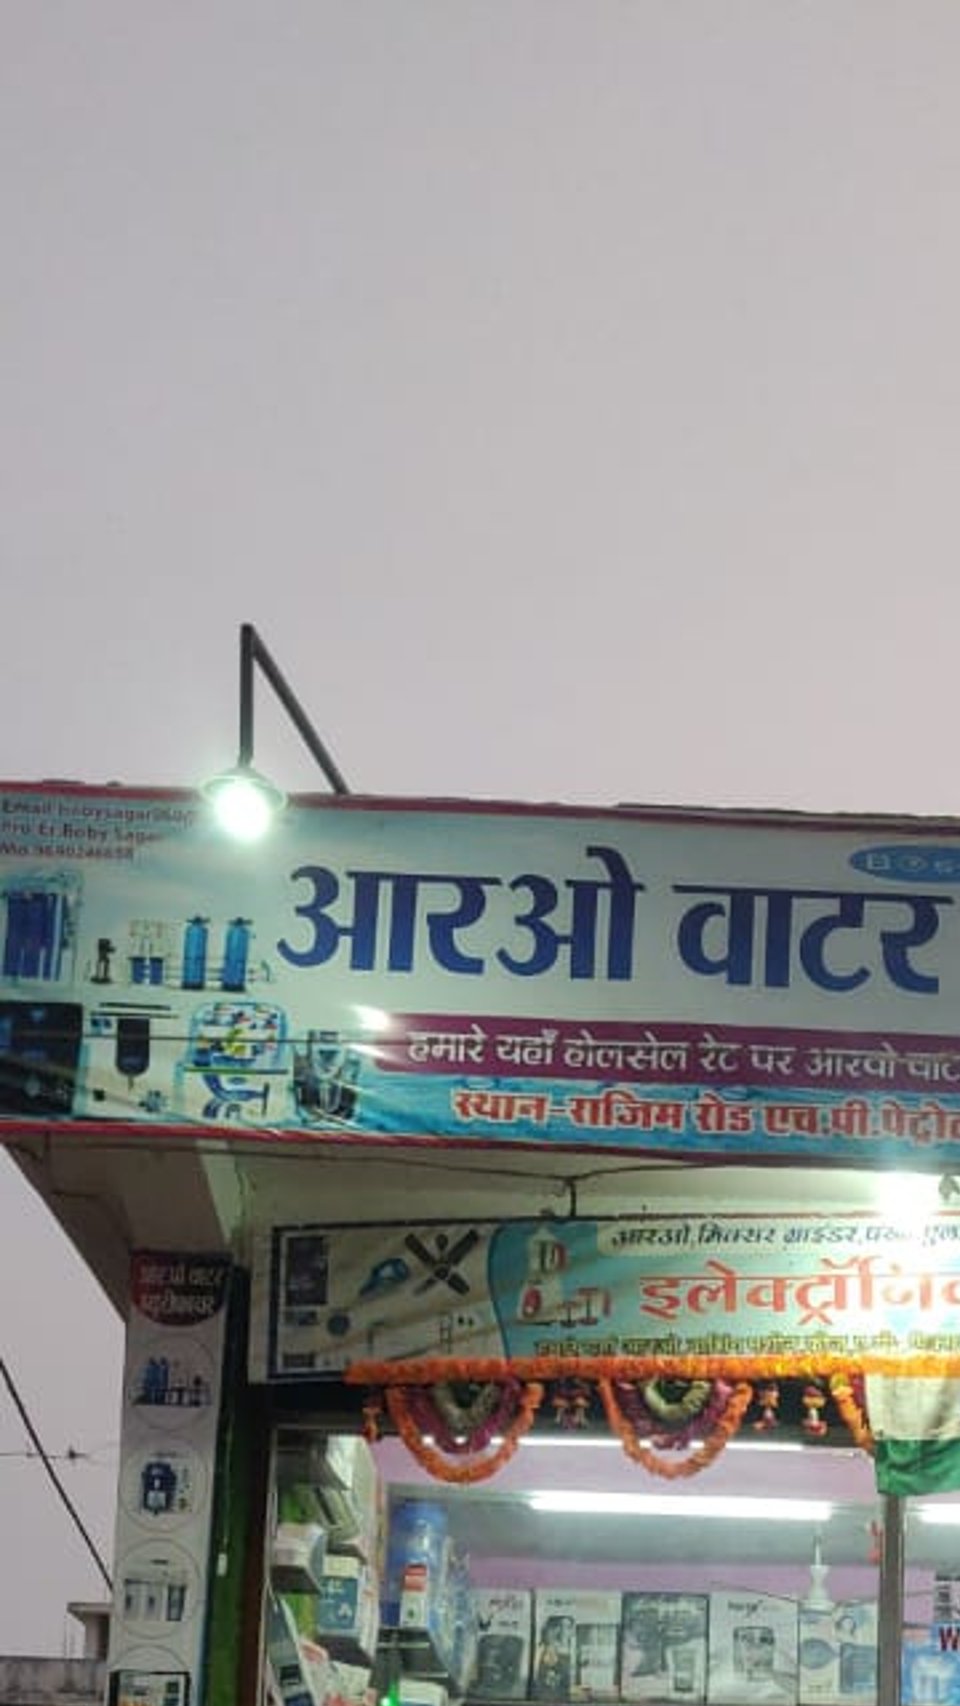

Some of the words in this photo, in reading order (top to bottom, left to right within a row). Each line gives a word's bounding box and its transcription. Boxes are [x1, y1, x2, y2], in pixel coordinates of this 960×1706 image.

[277, 845, 645, 982] आरओ
[672, 884, 954, 994] वाटर
[406, 1023, 489, 1065] हमारे
[563, 1029, 692, 1071] होलसेल
[700, 1031, 743, 1073] रेट
[750, 1044, 797, 1075] पर
[694, 1092, 755, 1133] रोड
